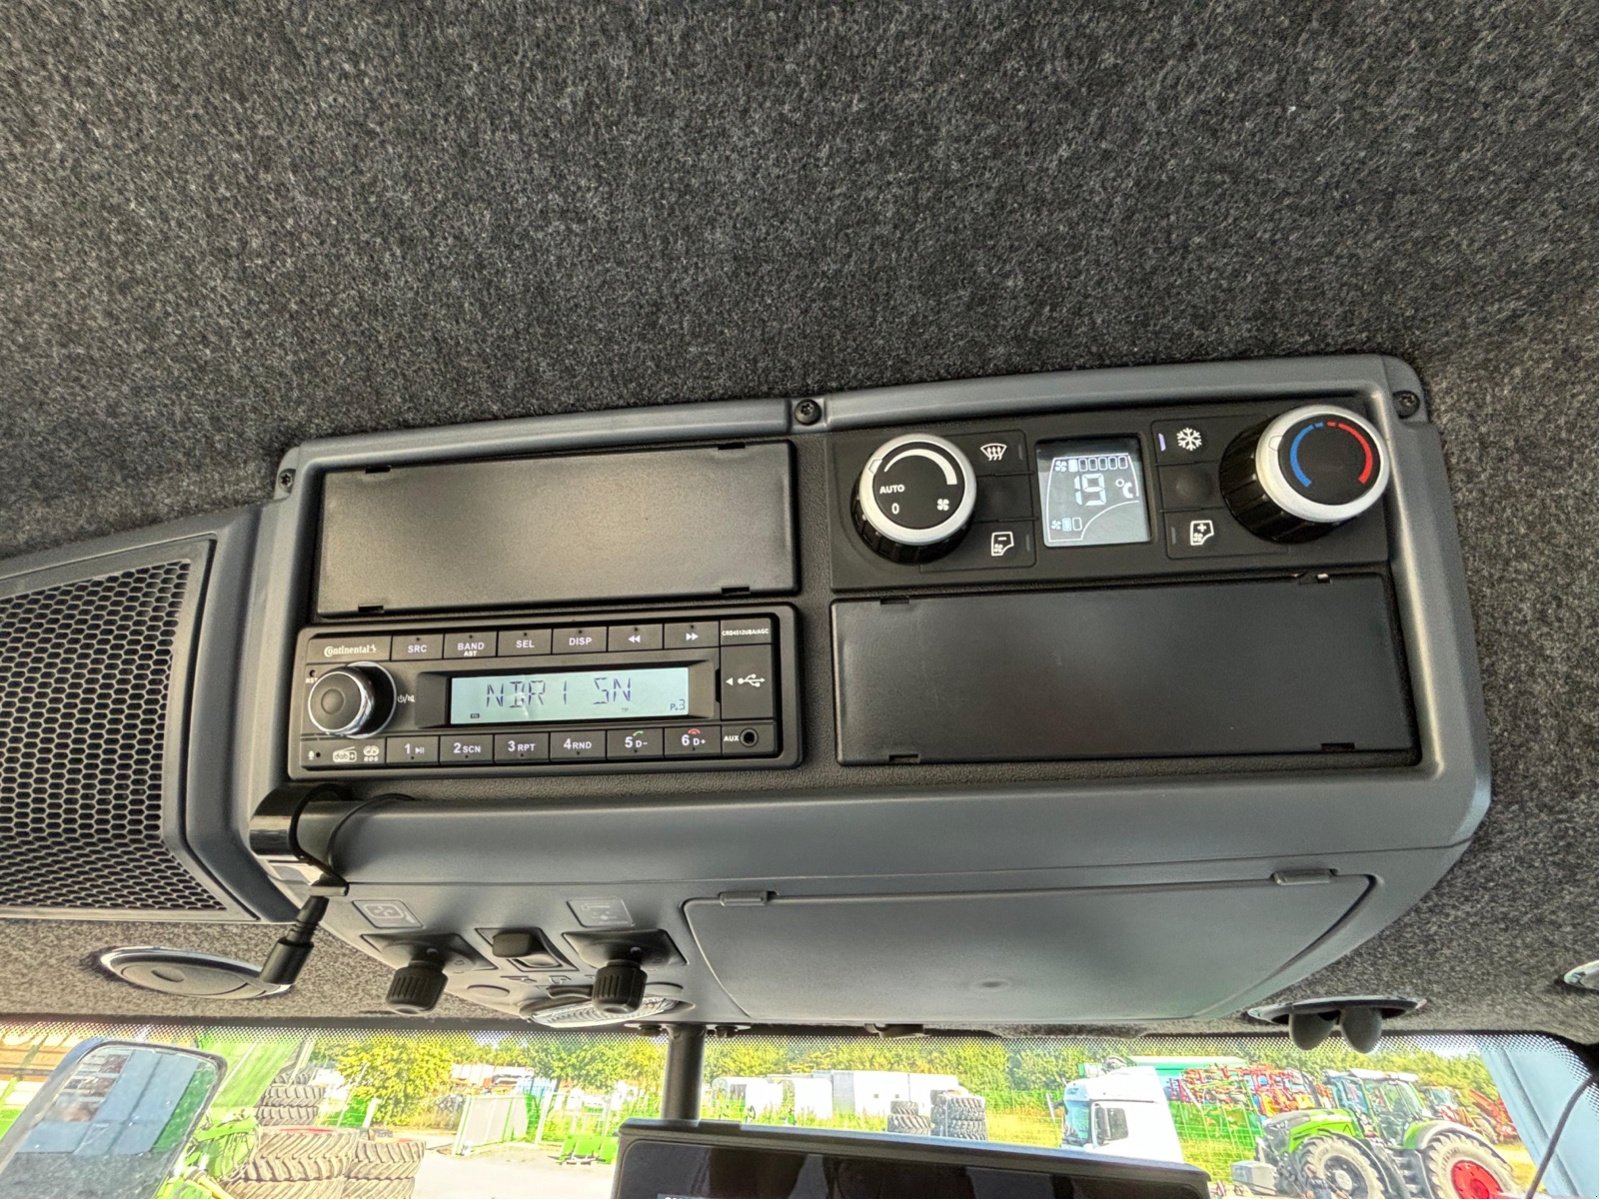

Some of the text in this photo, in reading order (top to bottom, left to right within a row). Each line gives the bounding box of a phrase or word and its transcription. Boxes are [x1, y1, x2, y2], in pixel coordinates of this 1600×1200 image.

[879, 484, 906, 494] AUTO
[1073, 473, 1107, 507] 19
[891, 502, 900, 515] 0
[457, 641, 485, 651] BAND
[515, 639, 535, 649] SEL
[568, 636, 592, 646] DISP
[323, 644, 371, 657] Continental
[407, 644, 428, 654] SRC
